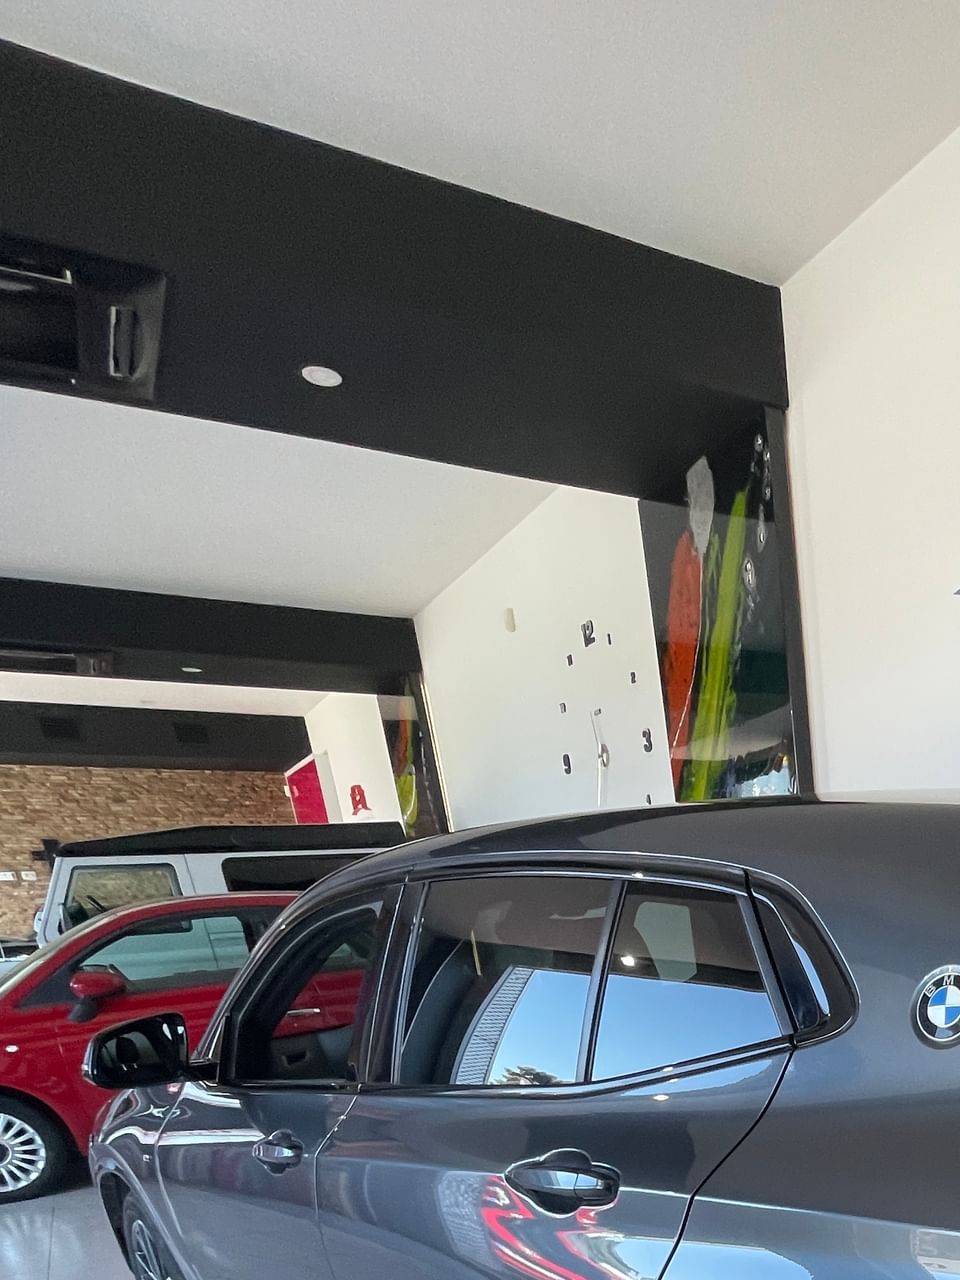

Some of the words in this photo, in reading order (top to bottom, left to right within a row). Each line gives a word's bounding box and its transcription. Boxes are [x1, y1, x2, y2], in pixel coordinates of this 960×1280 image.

[581, 620, 595, 647] 12
[630, 672, 636, 684] 2
[642, 728, 653, 753] 3
[563, 754, 572, 775] 9
